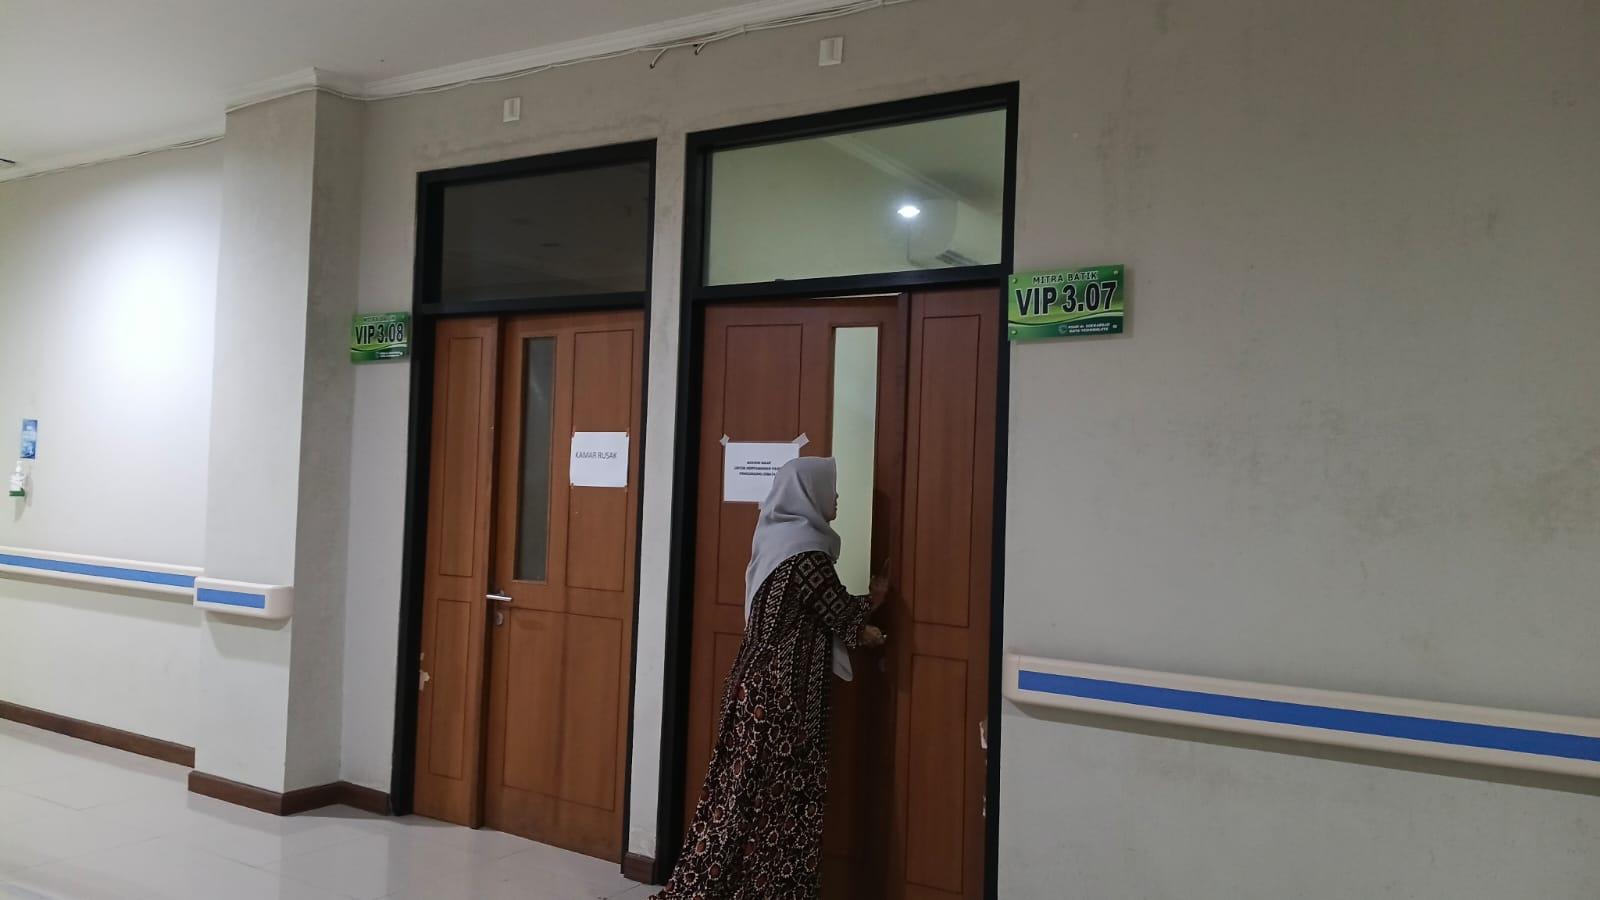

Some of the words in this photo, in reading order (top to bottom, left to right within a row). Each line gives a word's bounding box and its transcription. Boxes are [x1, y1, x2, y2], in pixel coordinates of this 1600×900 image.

[1032, 274, 1064, 285] MITRA
[1067, 270, 1098, 281] BATIK
[1015, 286, 1058, 317] VIP
[1061, 281, 1117, 313] 3.07
[355, 324, 375, 345] VIP
[377, 322, 404, 344] 3.08
[575, 451, 597, 459] KAMAR
[598, 451, 617, 460] RUSAK
